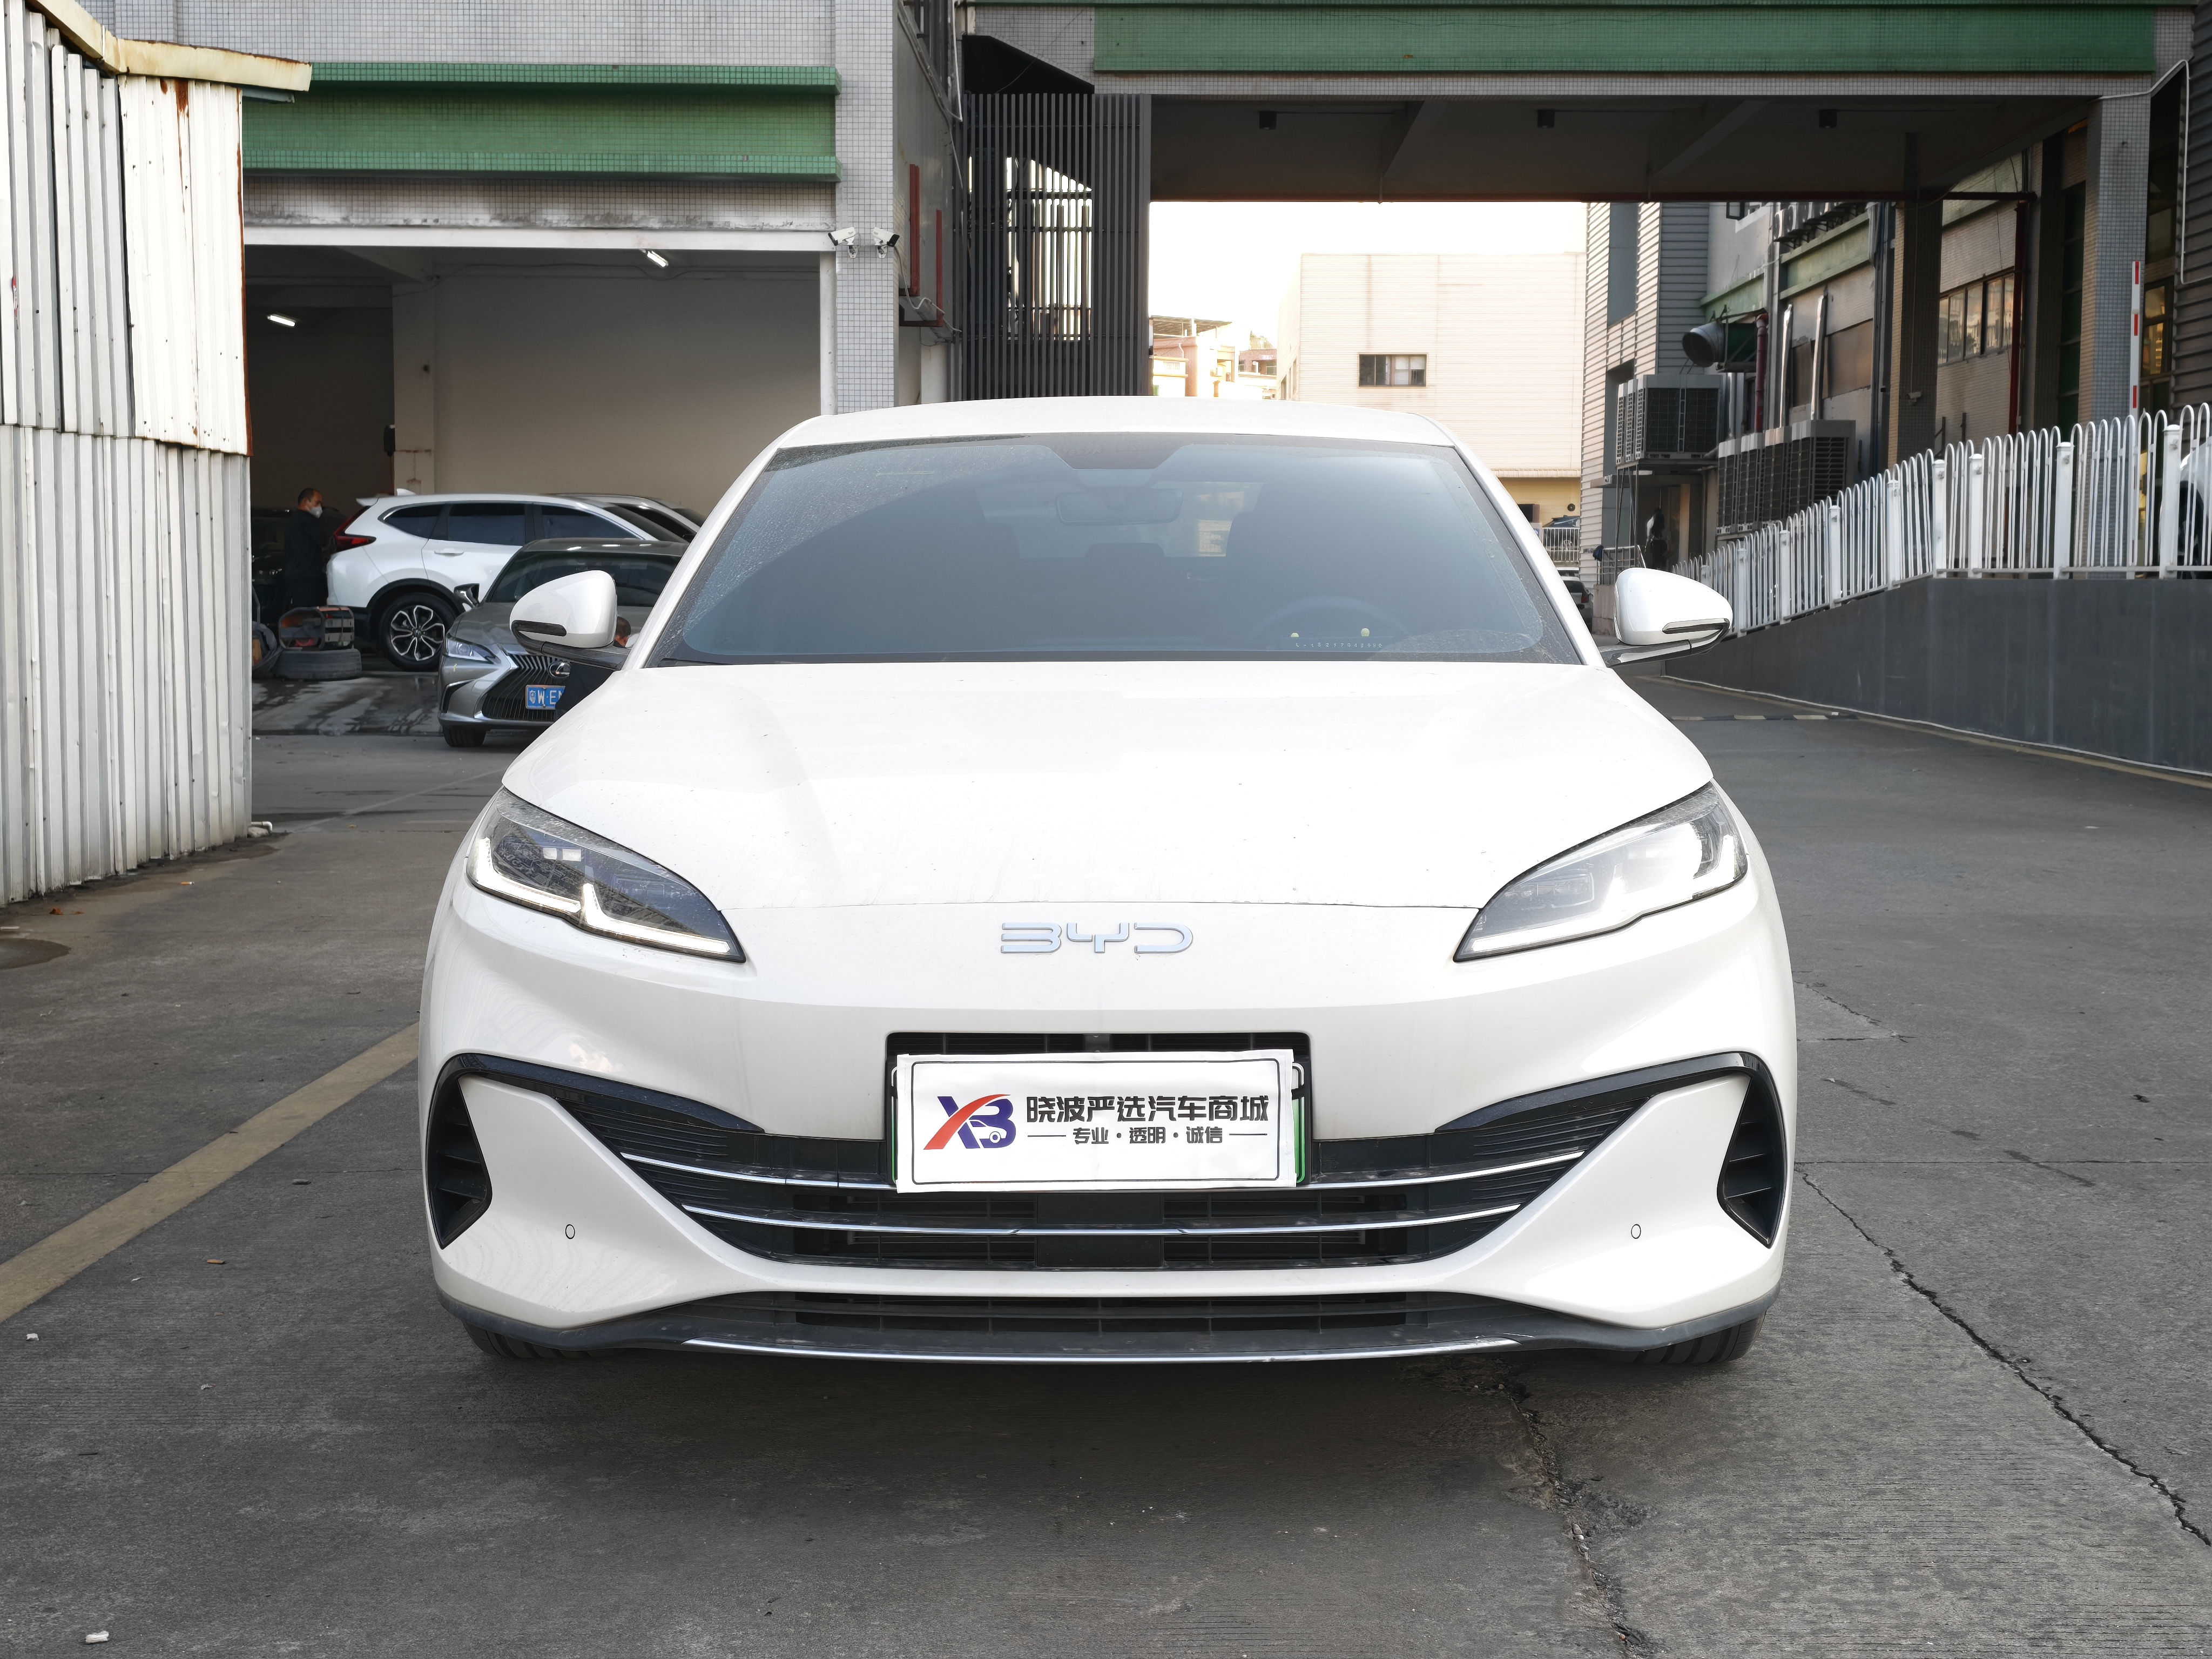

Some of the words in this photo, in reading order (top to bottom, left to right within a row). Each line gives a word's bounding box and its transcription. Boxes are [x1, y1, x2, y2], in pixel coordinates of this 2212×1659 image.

[1001, 922, 1194, 954] BYD
[923, 1094, 1016, 1150] XB
[1027, 1095, 1269, 1122] 晓波严选汽车商城
